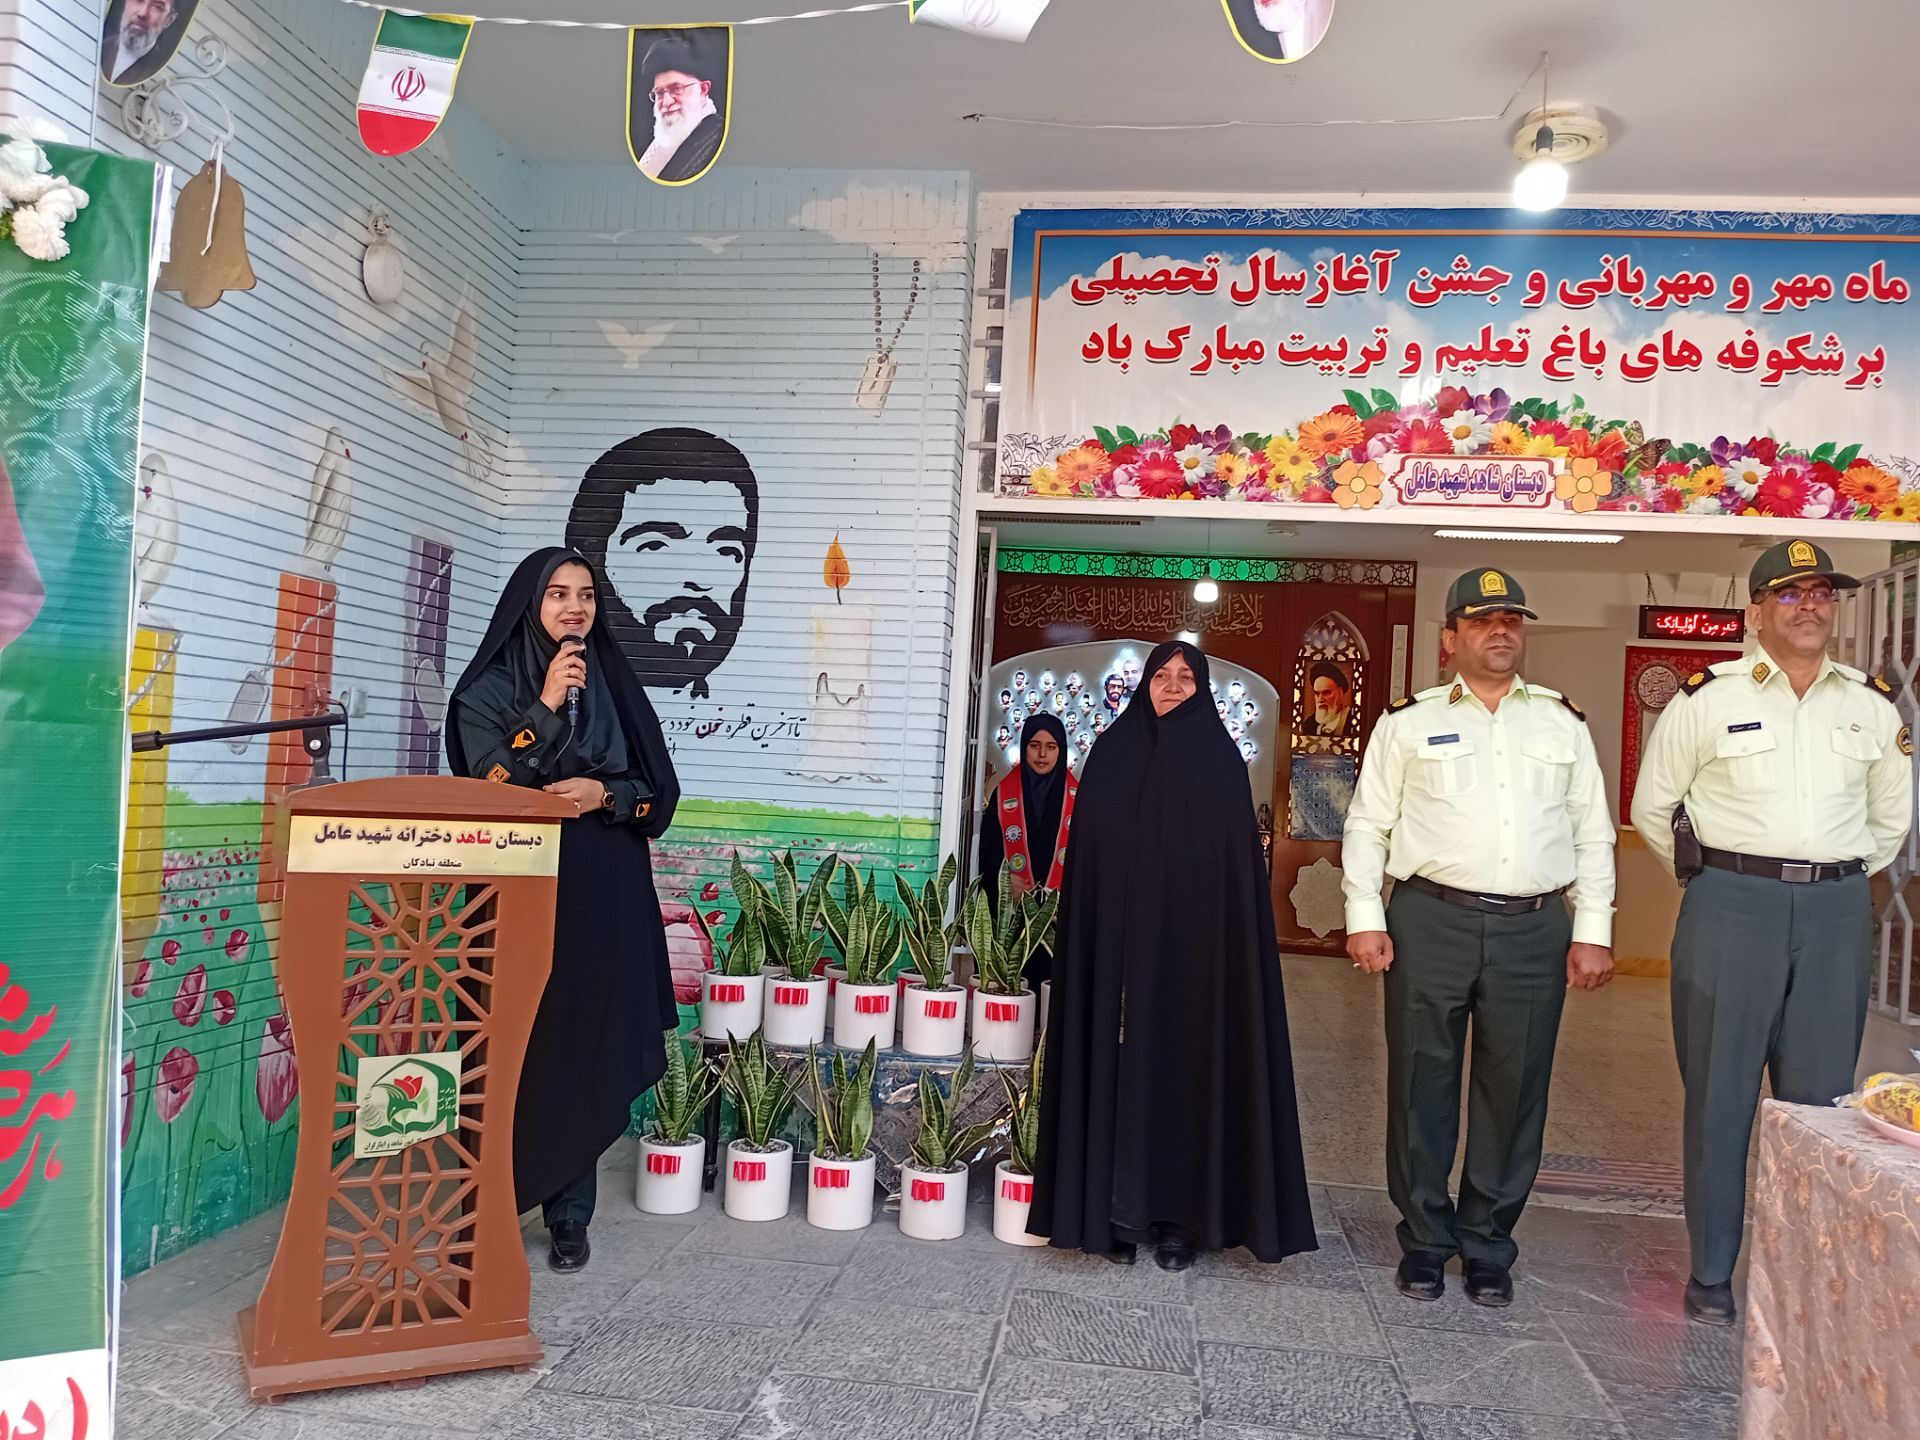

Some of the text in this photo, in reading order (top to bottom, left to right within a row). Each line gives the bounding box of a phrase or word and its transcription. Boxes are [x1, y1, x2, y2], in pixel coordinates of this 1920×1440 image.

[1070, 249, 1909, 312] ماه مهر و مهربانی و جشن آغاز سال تحصیلی
[1081, 322, 1886, 388] بر شکوفه های باغ تعلیم و تربیت مبارک باد
[1405, 462, 1546, 502] دبستان شاهد شهید عامل
[696, 707, 724, 738] خون
[726, 703, 755, 739] قطره
[315, 824, 542, 849] دبستان شاهد دخترانه شهید عامل
[437, 858, 462, 868] منطقه
